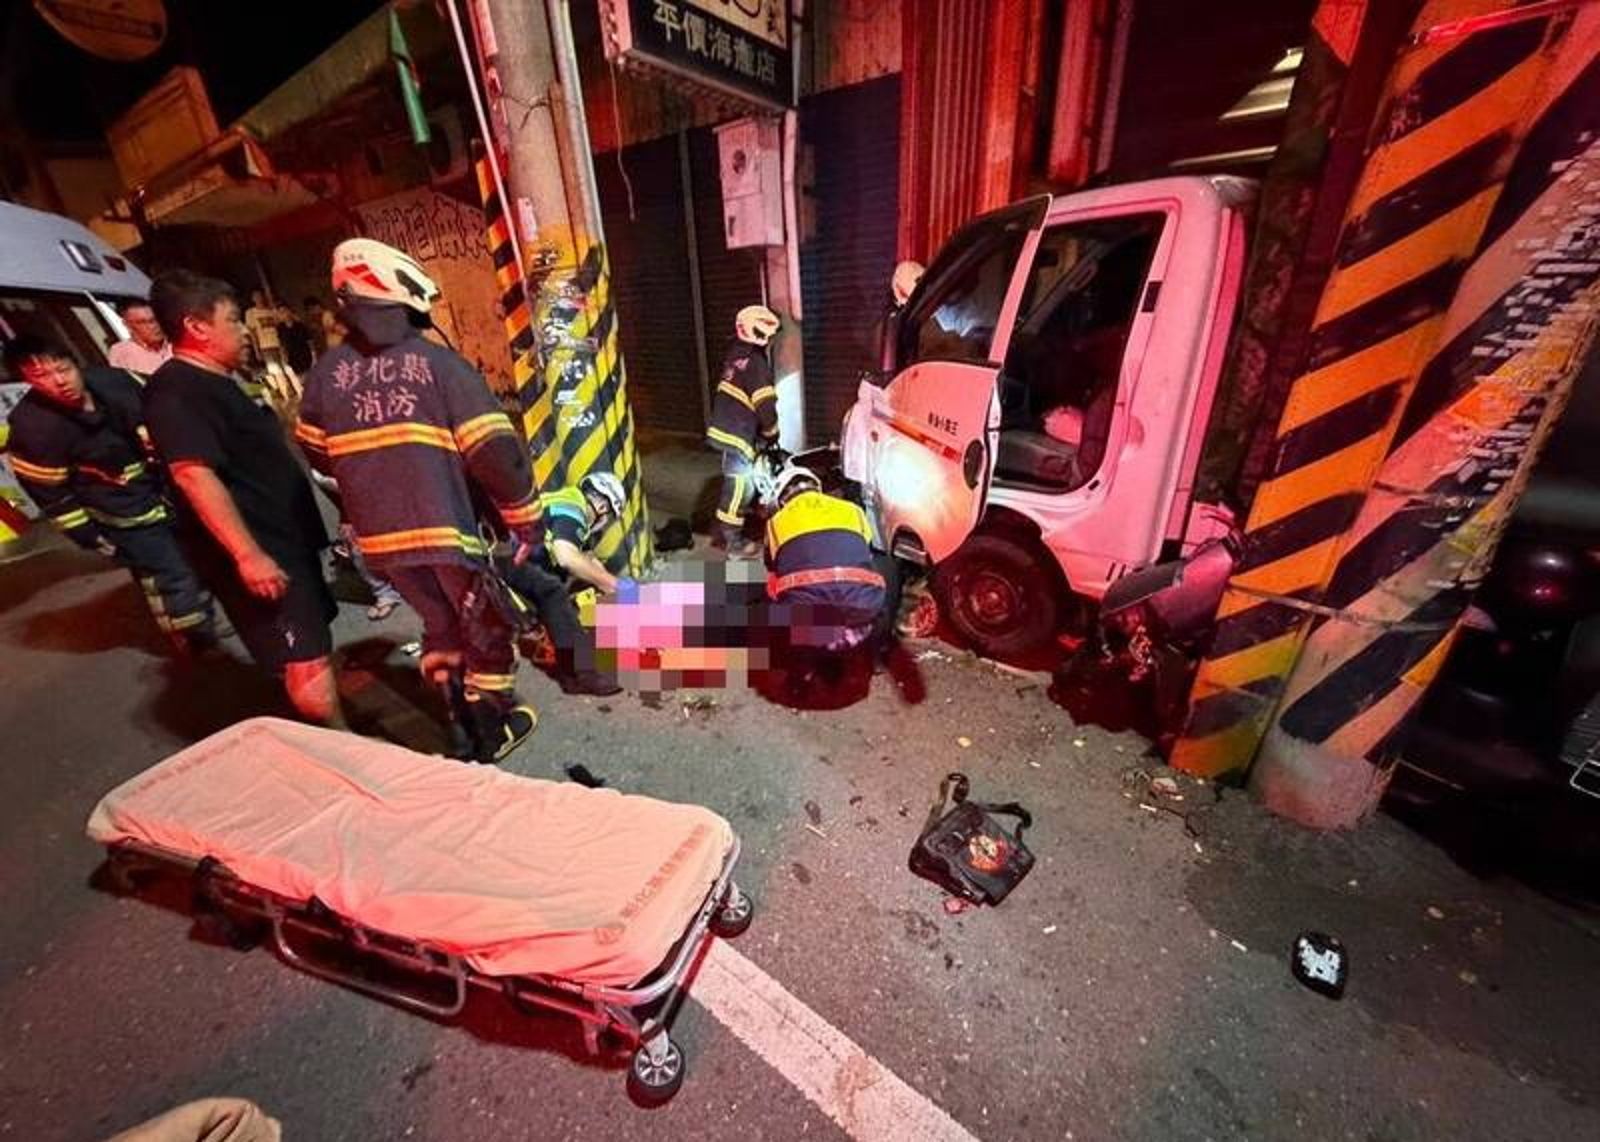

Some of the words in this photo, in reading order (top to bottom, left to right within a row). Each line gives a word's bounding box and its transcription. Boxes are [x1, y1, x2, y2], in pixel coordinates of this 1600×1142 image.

[334, 353, 433, 389] 彰化縣
[353, 386, 418, 422] 消防
